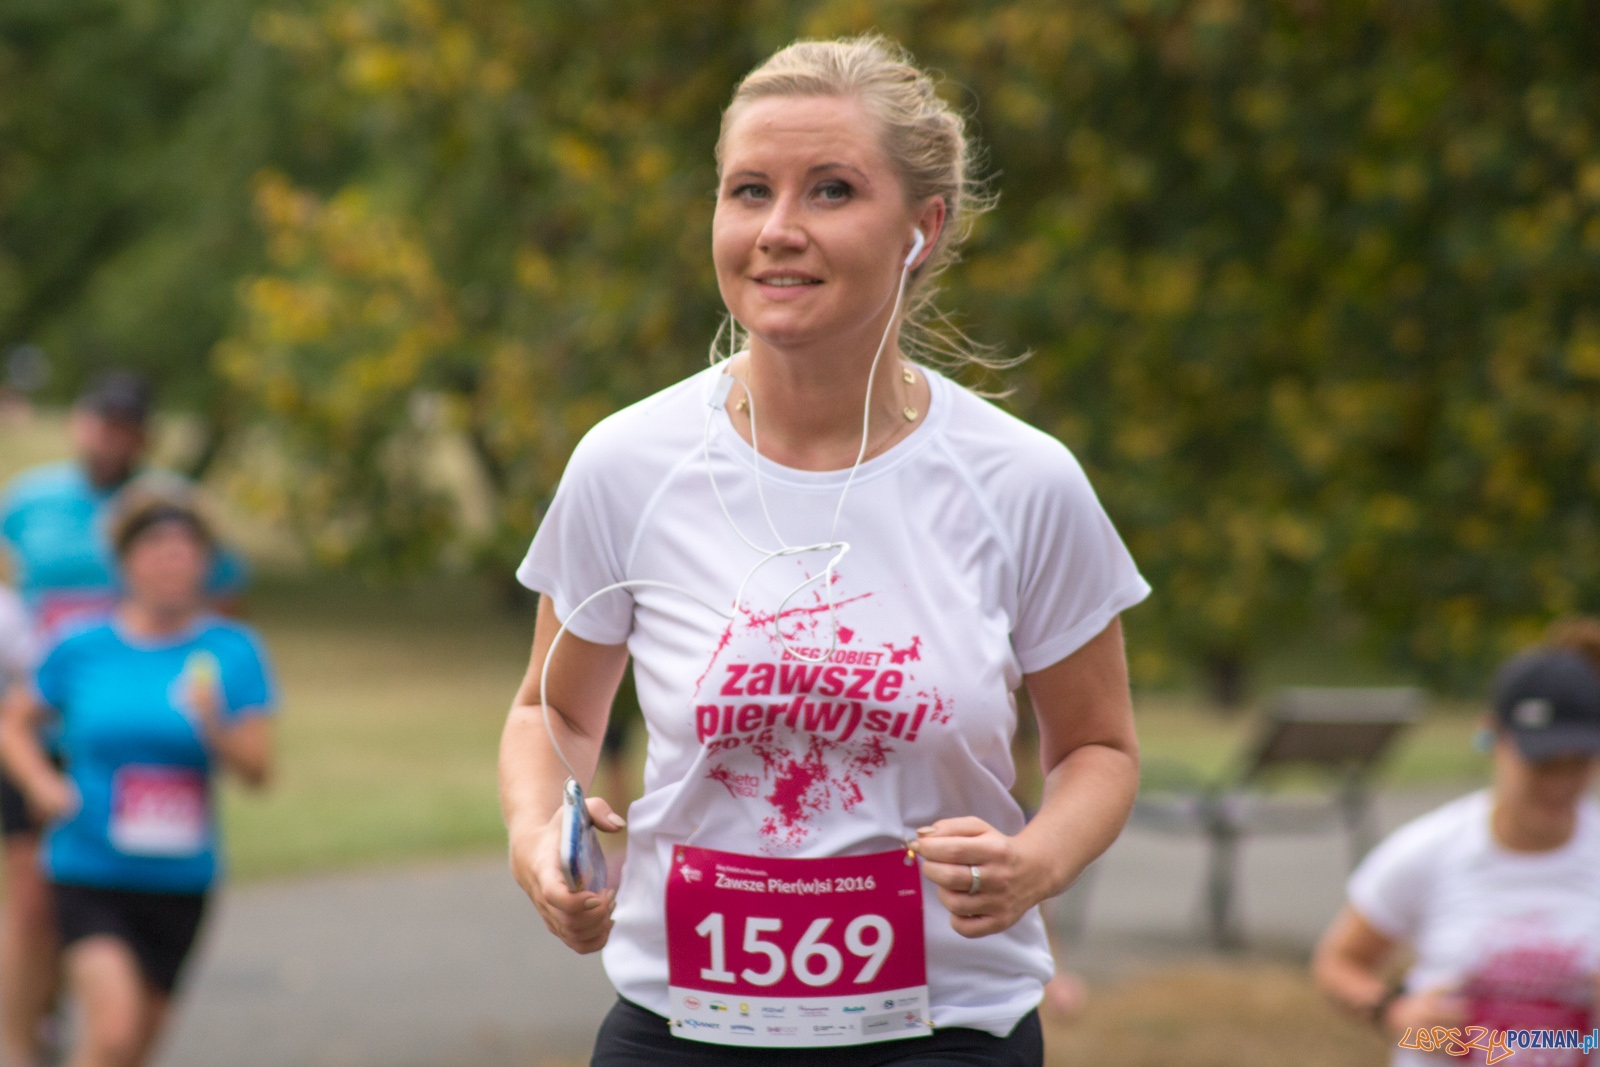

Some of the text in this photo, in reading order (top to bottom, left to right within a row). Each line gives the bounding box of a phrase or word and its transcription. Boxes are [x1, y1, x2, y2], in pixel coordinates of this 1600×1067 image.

[824, 648, 884, 666] KOBIET
[720, 663, 904, 702] zawsze
[715, 873, 766, 893] Zawsze
[767, 878, 832, 895] Pier(w)si
[834, 876, 876, 893] 2016
[694, 912, 894, 987] 1569
